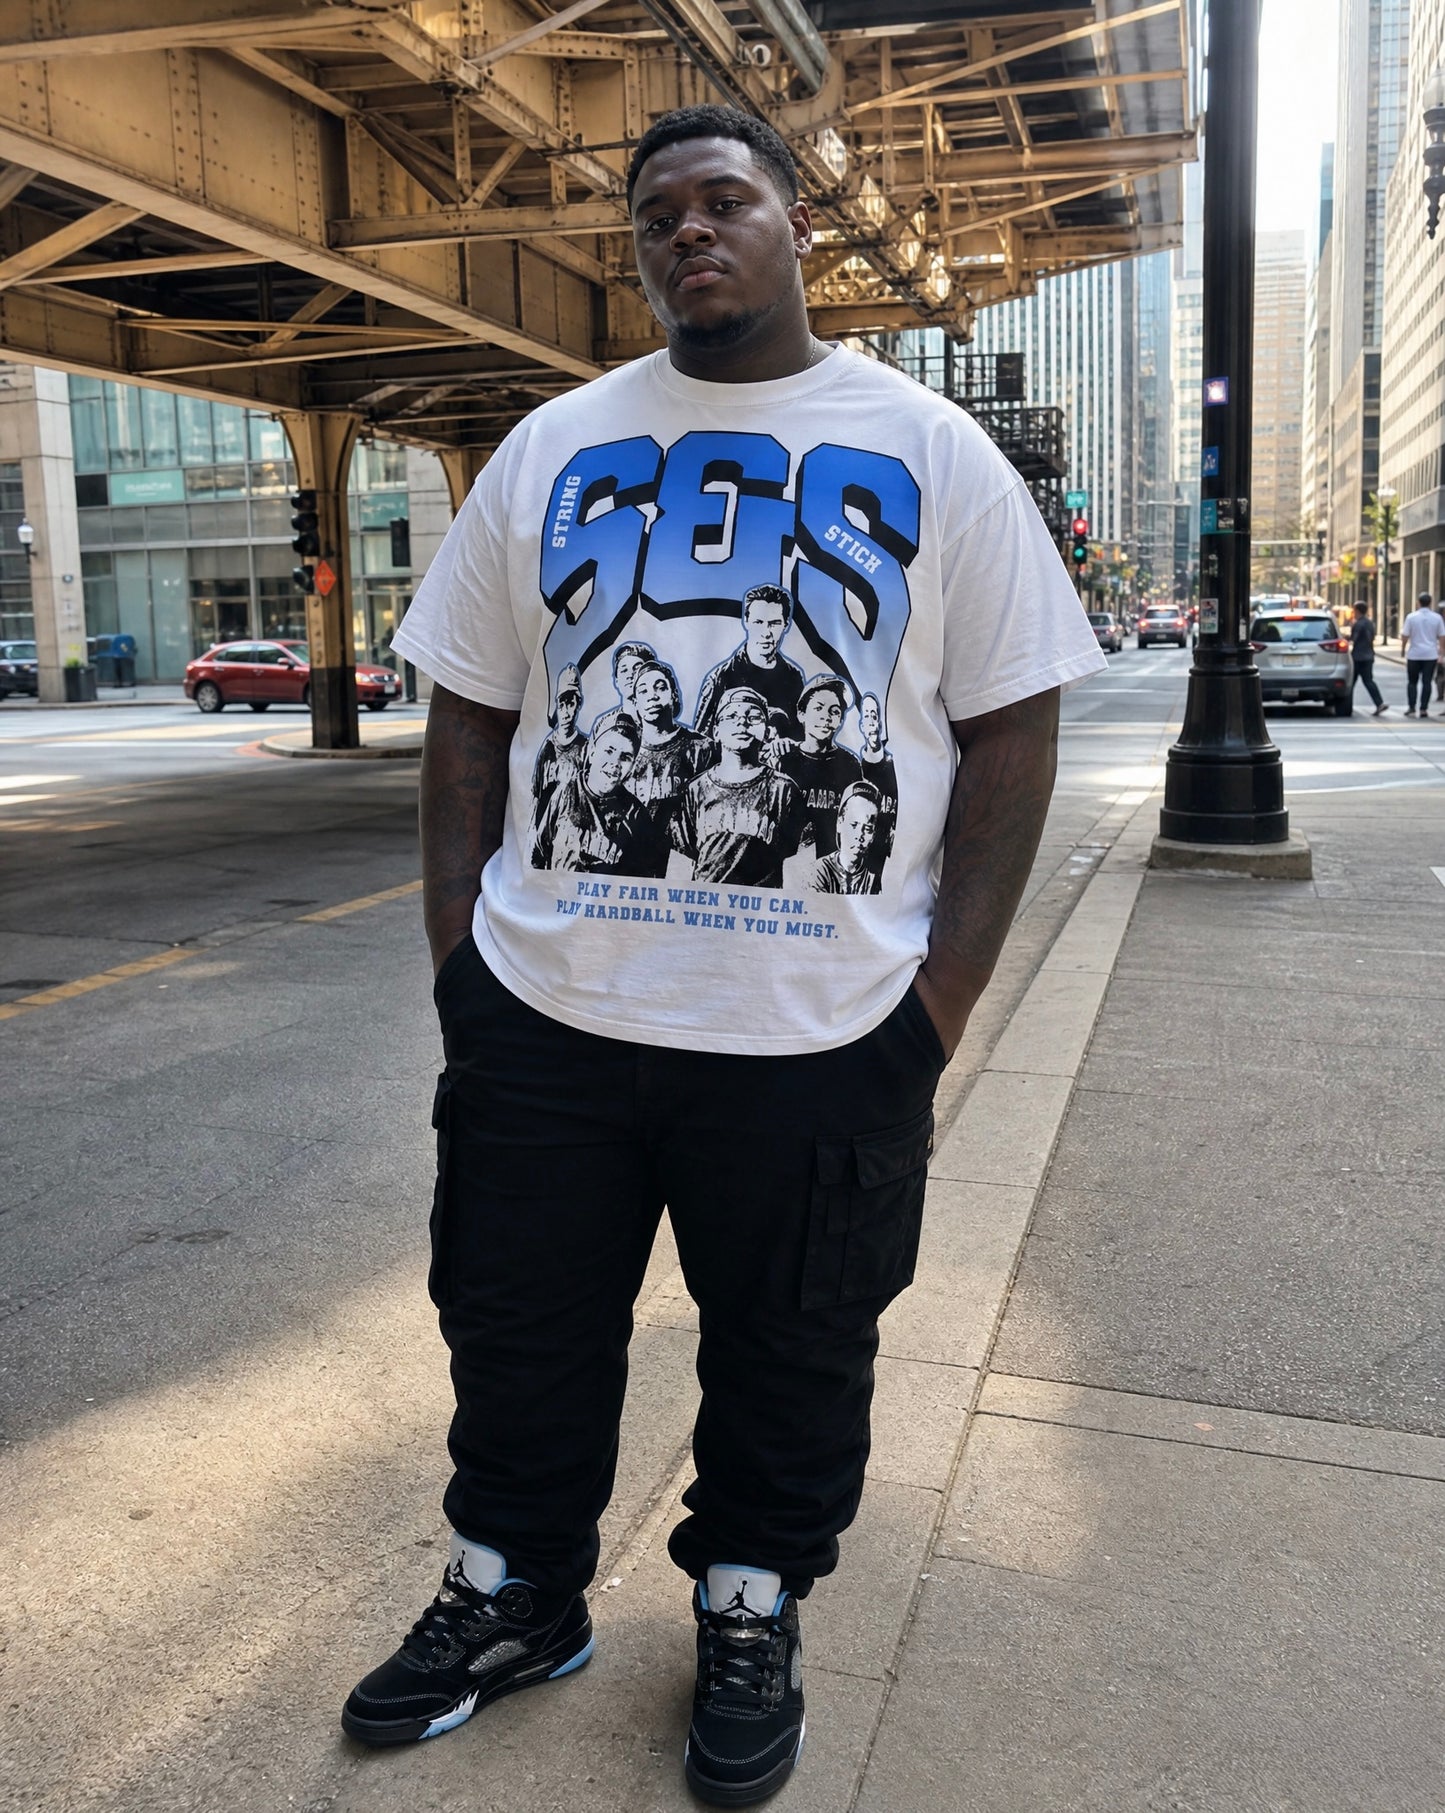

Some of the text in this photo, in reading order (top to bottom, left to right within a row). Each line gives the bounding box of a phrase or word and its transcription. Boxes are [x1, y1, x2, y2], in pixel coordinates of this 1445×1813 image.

[552, 475, 581, 548] STRING
[824, 525, 882, 574] STICK
[556, 899, 839, 939] PLAY HARDBALL WHEN YOU MUST.
[577, 881, 808, 915] PLAY FAIR WHEN YOU CAN.
